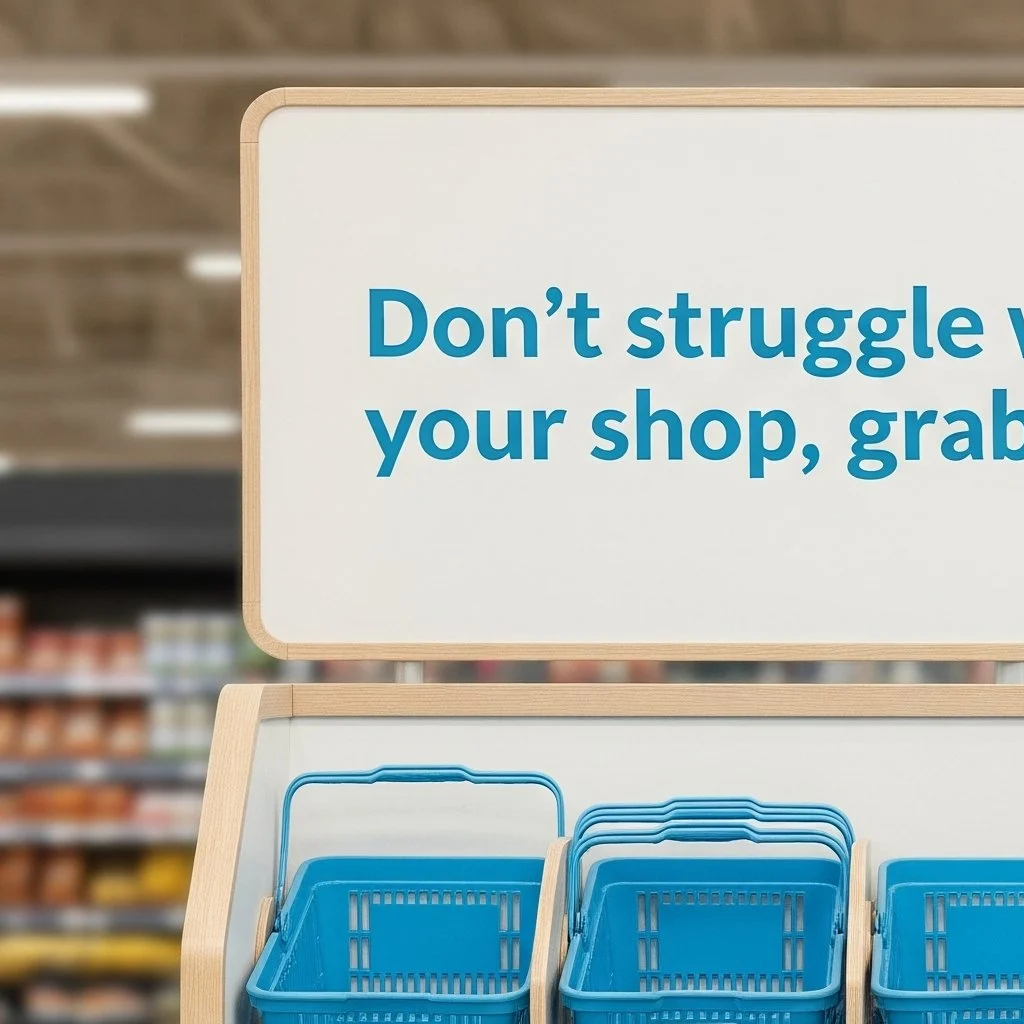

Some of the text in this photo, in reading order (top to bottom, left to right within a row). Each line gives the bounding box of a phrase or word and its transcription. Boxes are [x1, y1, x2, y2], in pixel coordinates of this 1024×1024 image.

[368, 286, 603, 359] Don’t
[626, 286, 985, 379] struggle
[365, 409, 567, 478] your
[590, 387, 821, 479] shop,
